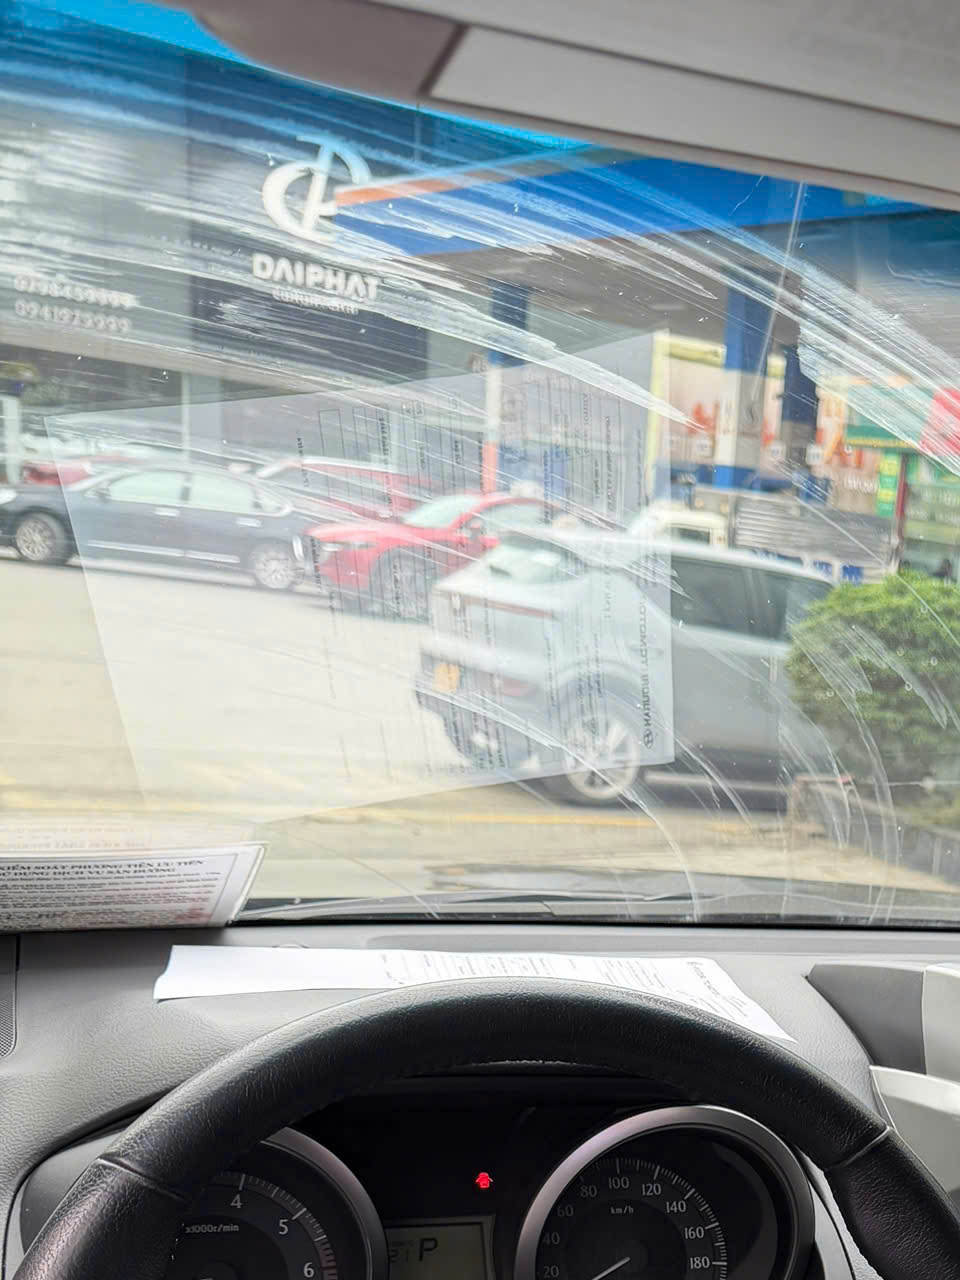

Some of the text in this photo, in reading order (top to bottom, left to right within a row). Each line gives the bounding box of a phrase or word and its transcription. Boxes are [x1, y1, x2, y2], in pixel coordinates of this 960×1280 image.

[608, 1177, 629, 1189] 100
[580, 1185, 598, 1198] 80
[642, 1184, 661, 1196] 120
[230, 1193, 242, 1208] 4
[611, 1206, 634, 1215] km/h
[666, 1201, 686, 1214] 140
[278, 1219, 289, 1235] 5
[684, 1227, 704, 1240] 160
[418, 1237, 438, 1262] P
[690, 1256, 710, 1269] 180
[303, 1262, 314, 1278] 6
